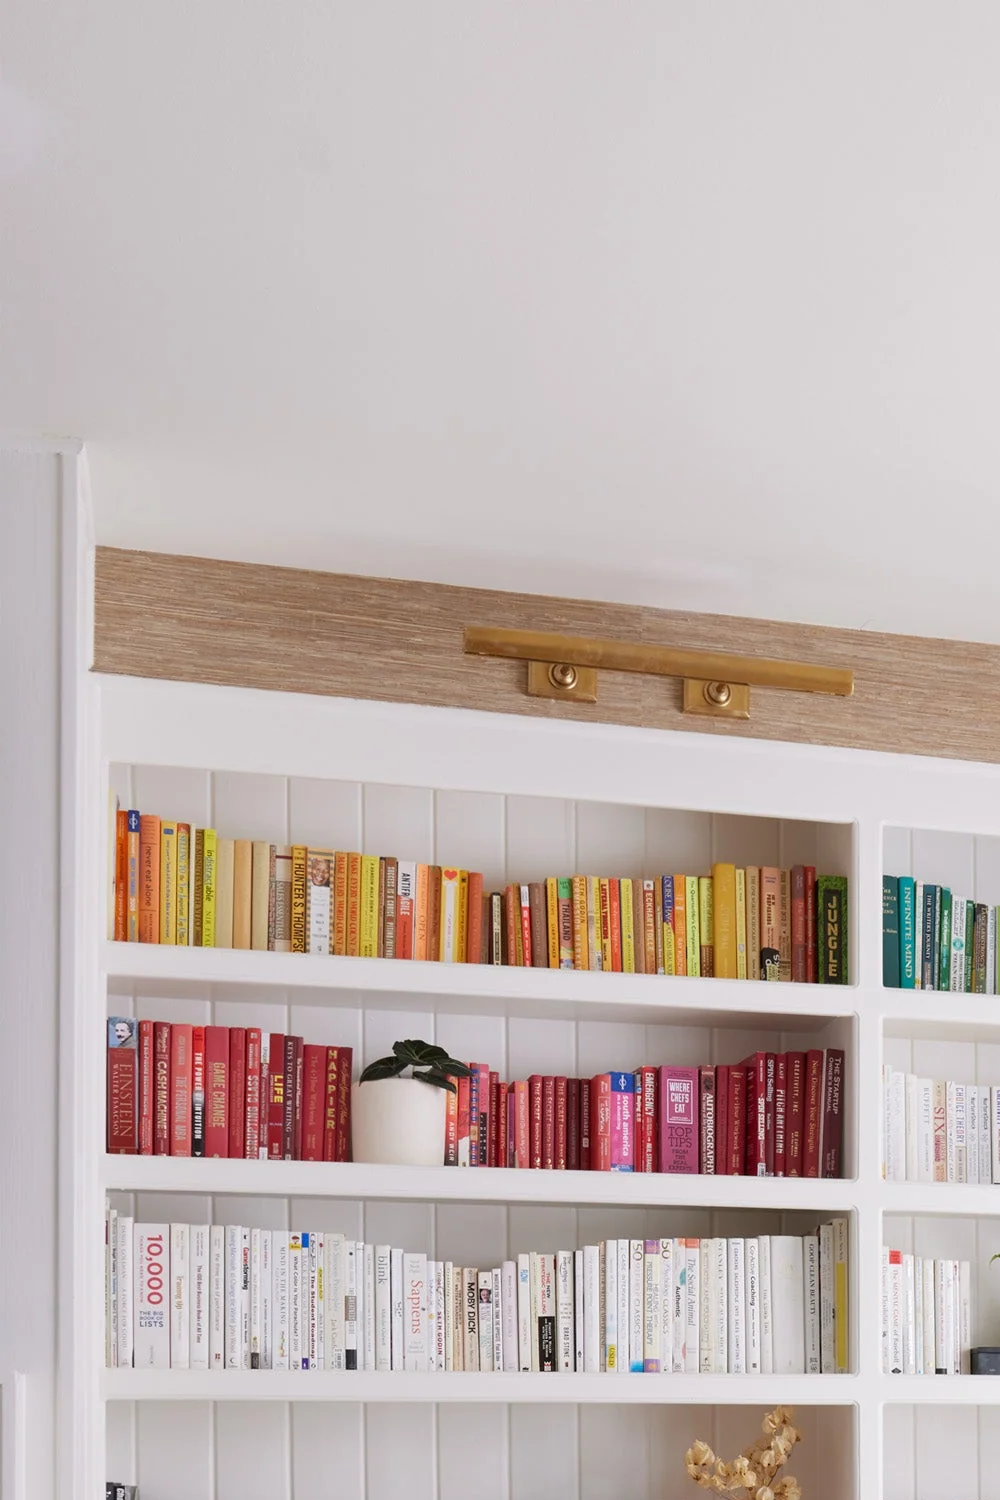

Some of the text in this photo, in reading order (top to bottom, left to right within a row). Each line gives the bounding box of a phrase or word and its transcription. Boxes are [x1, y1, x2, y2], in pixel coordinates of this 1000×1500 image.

[145, 846, 153, 868] never
[145, 869, 154, 882] eat
[205, 849, 214, 902] indistractable
[293, 863, 304, 899] HUNTER
[145, 884, 154, 906] alone
[293, 901, 304, 911] S.
[400, 873, 411, 916] ANTIFRAGILE
[645, 892, 653, 927] ECKHART
[275, 882, 284, 939] SALES ESSENTIALS
[562, 904, 570, 941] THAILAND
[418, 915, 426, 941] OPEN
[827, 895, 839, 977] JUNGLE
[157, 1061, 167, 1089] CASH
[287, 1062, 293, 1072] TO
[119, 1063, 132, 1137] EINSTEIN
[213, 1062, 225, 1128] GAME CHANGE
[274, 1075, 283, 1103] LIFE
[645, 1072, 654, 1116] EMERGENCY
[669, 1082, 691, 1093] WHERE
[671, 1092, 690, 1104] CHEFS
[766, 1079, 774, 1102] Selling
[810, 1077, 818, 1104] Discover
[832, 1058, 841, 1114] THE STARTUP
[157, 1090, 166, 1129] MACHINE
[194, 1103, 202, 1139] INTUITION
[674, 1103, 685, 1113] EAT
[775, 1089, 785, 1154] PITCH ANYTHING
[934, 1107, 944, 1133] SIX
[956, 1087, 965, 1143] CHOICE THEORY
[668, 1127, 693, 1137] TOP
[668, 1137, 693, 1148] TIPS
[706, 1093, 714, 1175] AUTOBIOGRAPHY
[808, 1123, 816, 1153] Strengths
[632, 1242, 642, 1262] 50
[145, 1234, 163, 1305] 10,000
[280, 1268, 286, 1276] IN
[377, 1255, 387, 1285] blink
[520, 1269, 528, 1283] FLOW
[407, 1279, 424, 1335] Sapiens
[688, 1258, 696, 1327] The Social Animal
[467, 1282, 476, 1334] MOBY DICK
